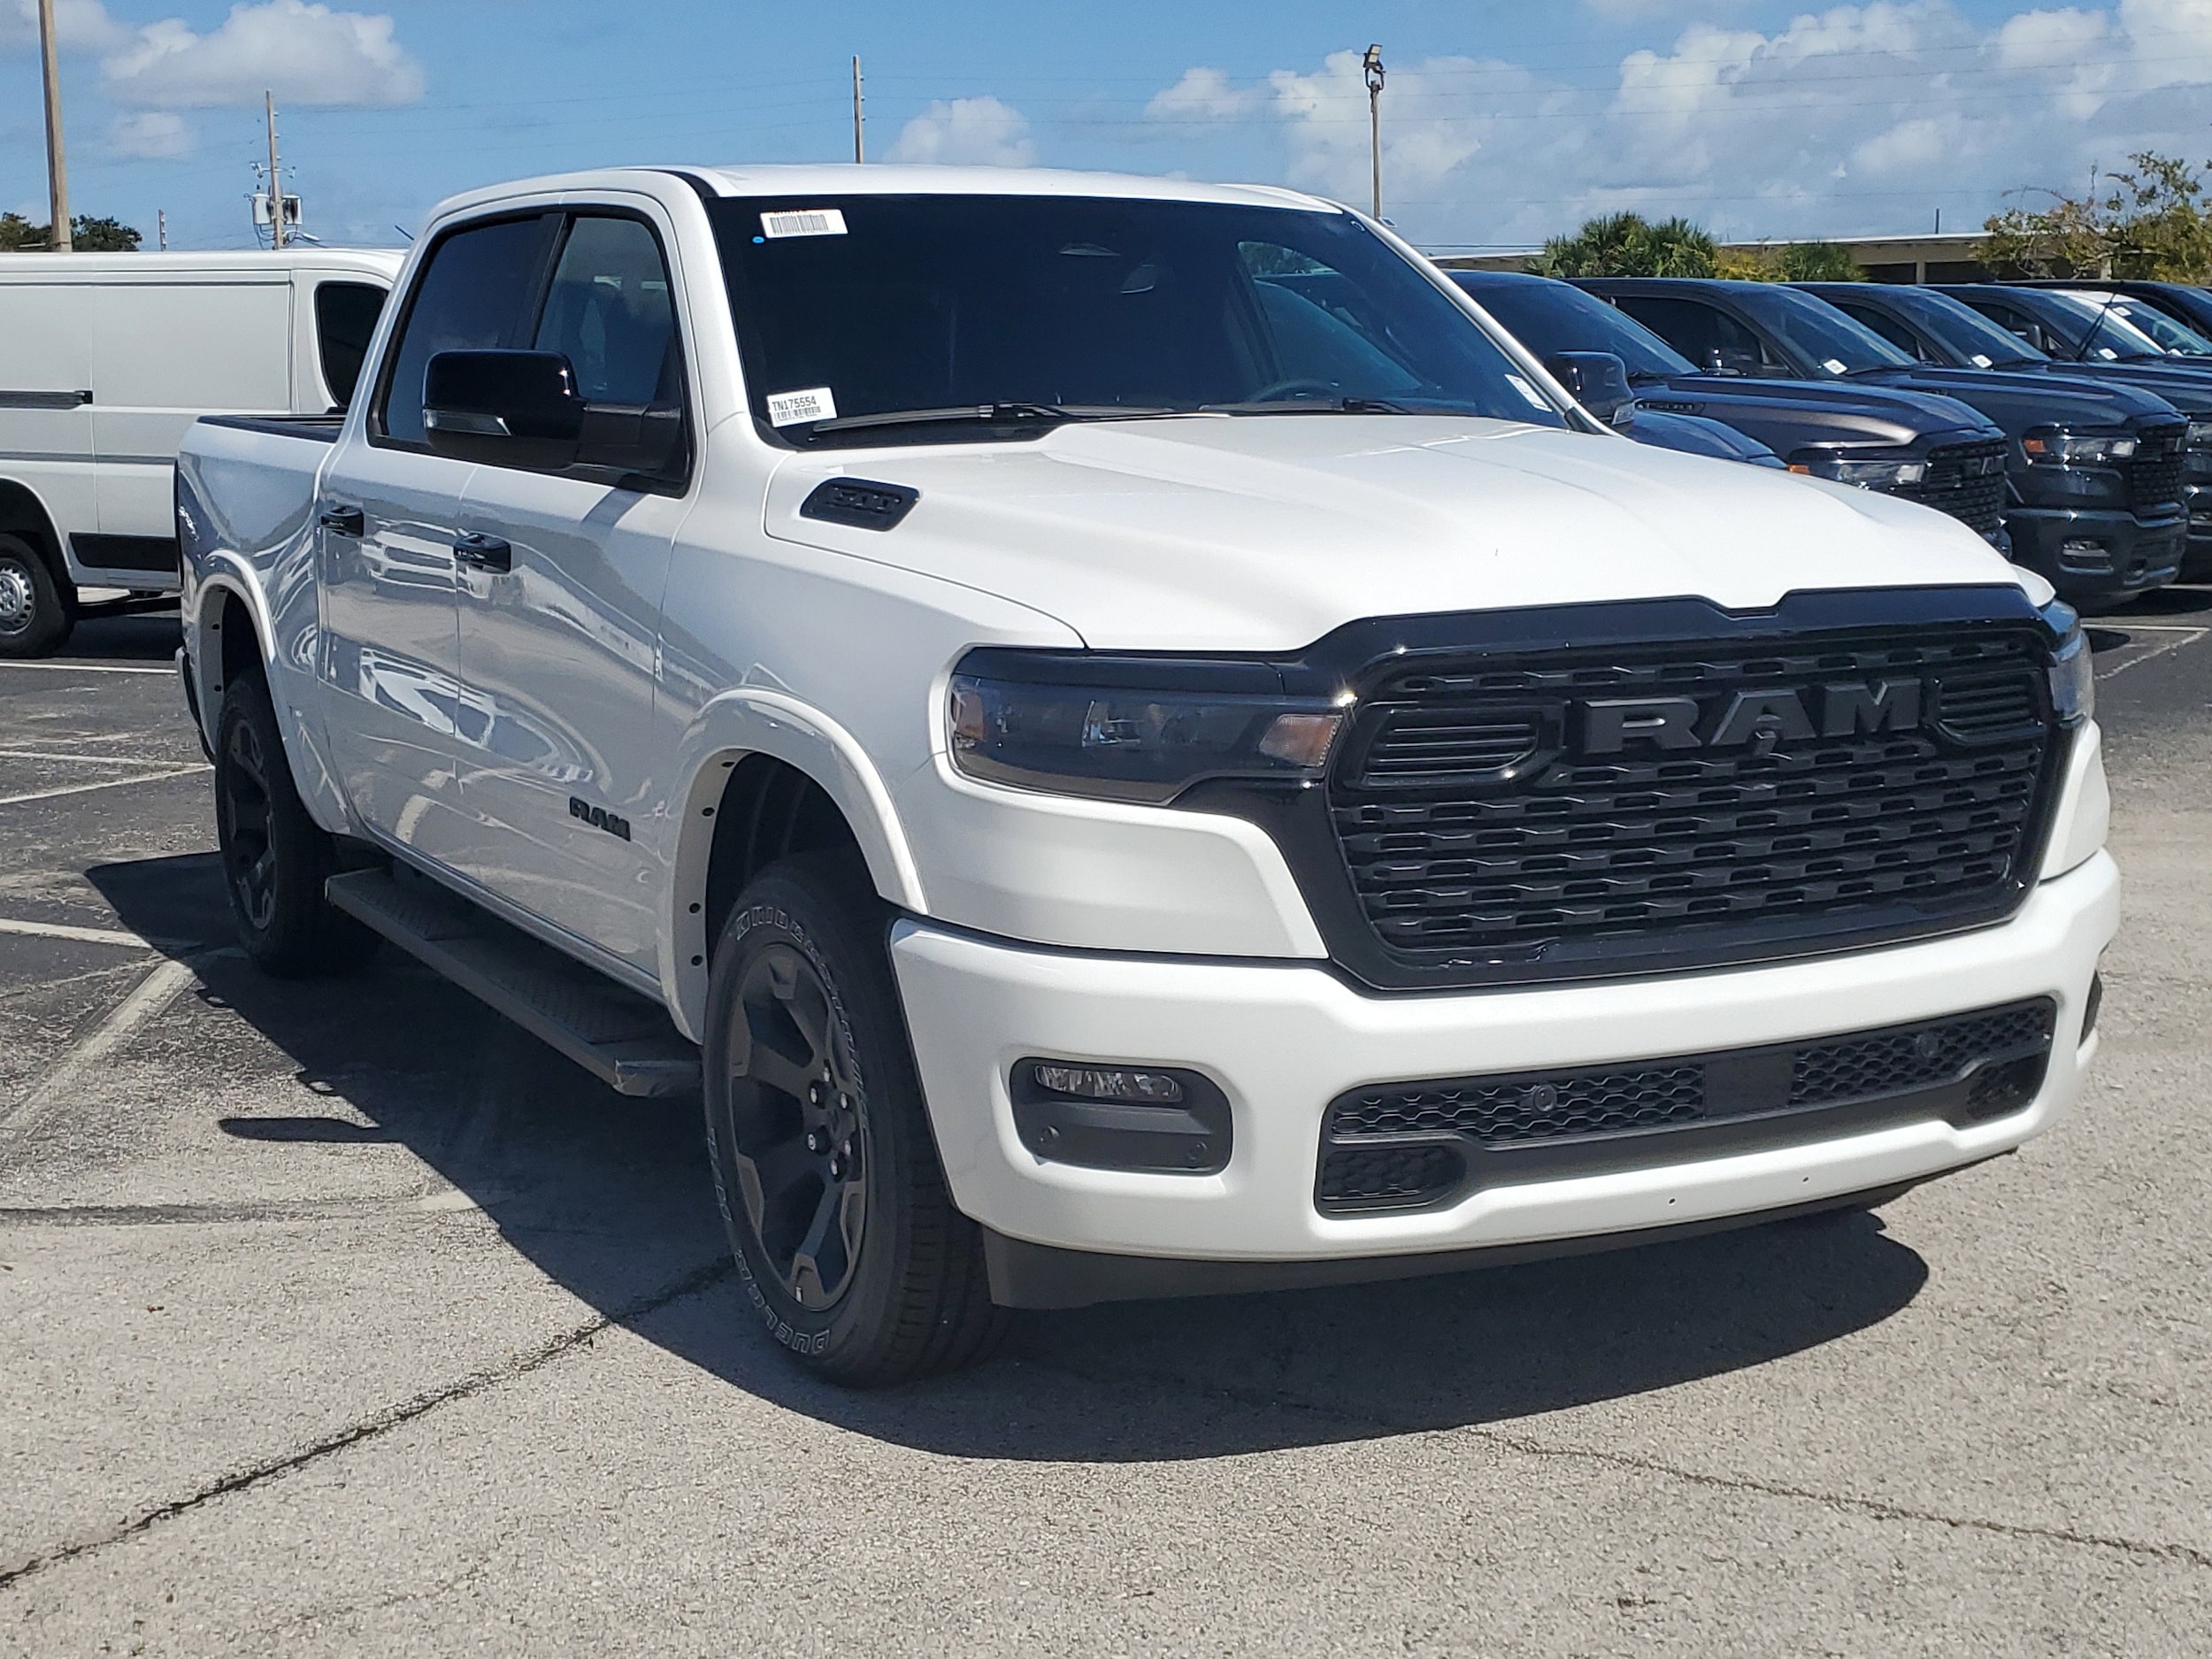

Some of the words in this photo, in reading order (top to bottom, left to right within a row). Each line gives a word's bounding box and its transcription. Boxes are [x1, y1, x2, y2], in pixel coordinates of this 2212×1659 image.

[772, 396, 817, 411] TN175554
[1583, 678, 1923, 754] RAM
[569, 796, 632, 842] RAM
[734, 1248, 831, 1355] DUELER
